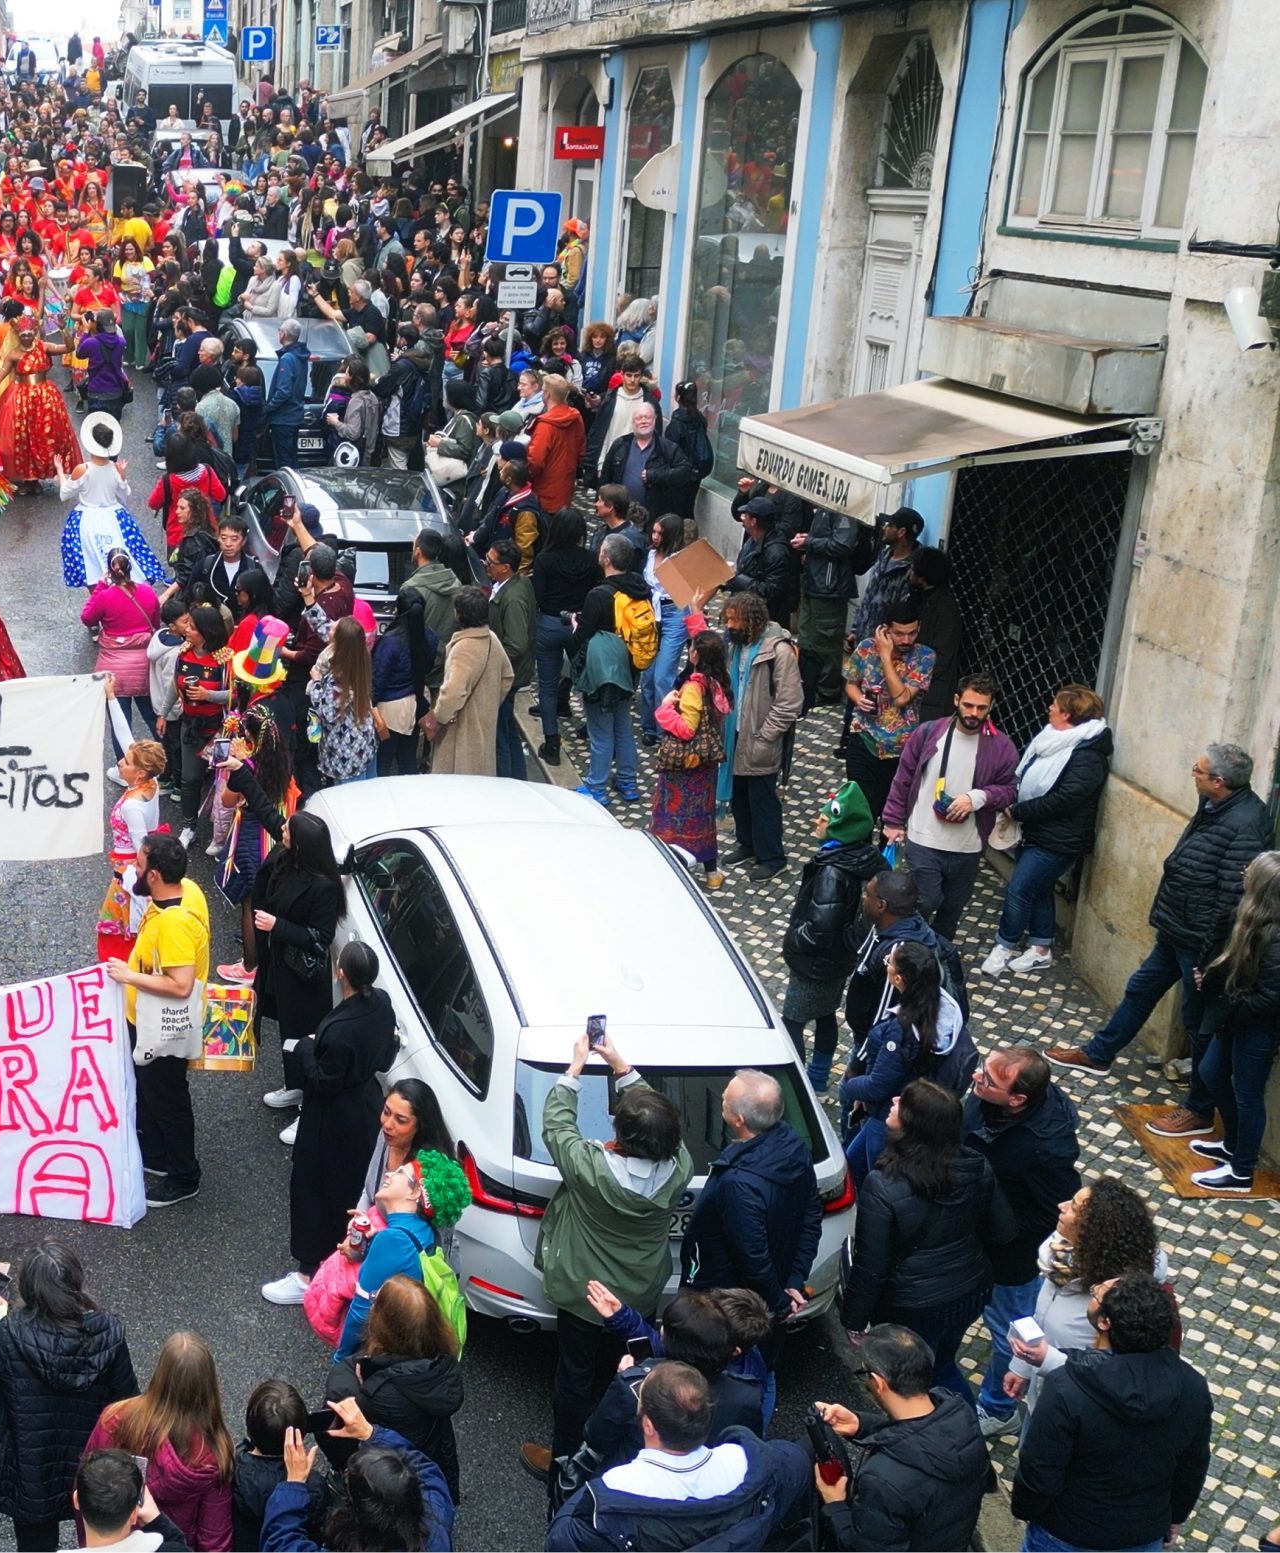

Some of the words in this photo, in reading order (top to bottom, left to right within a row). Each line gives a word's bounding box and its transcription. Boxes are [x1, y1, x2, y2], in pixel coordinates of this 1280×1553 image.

[248, 30, 267, 58] P
[318, 27, 327, 41] P
[502, 198, 546, 256] P
[755, 448, 797, 485] EDUARDO
[830, 476, 851, 508] LDA
[161, 1005, 189, 1015] shared
[161, 1015, 190, 1024] spaces
